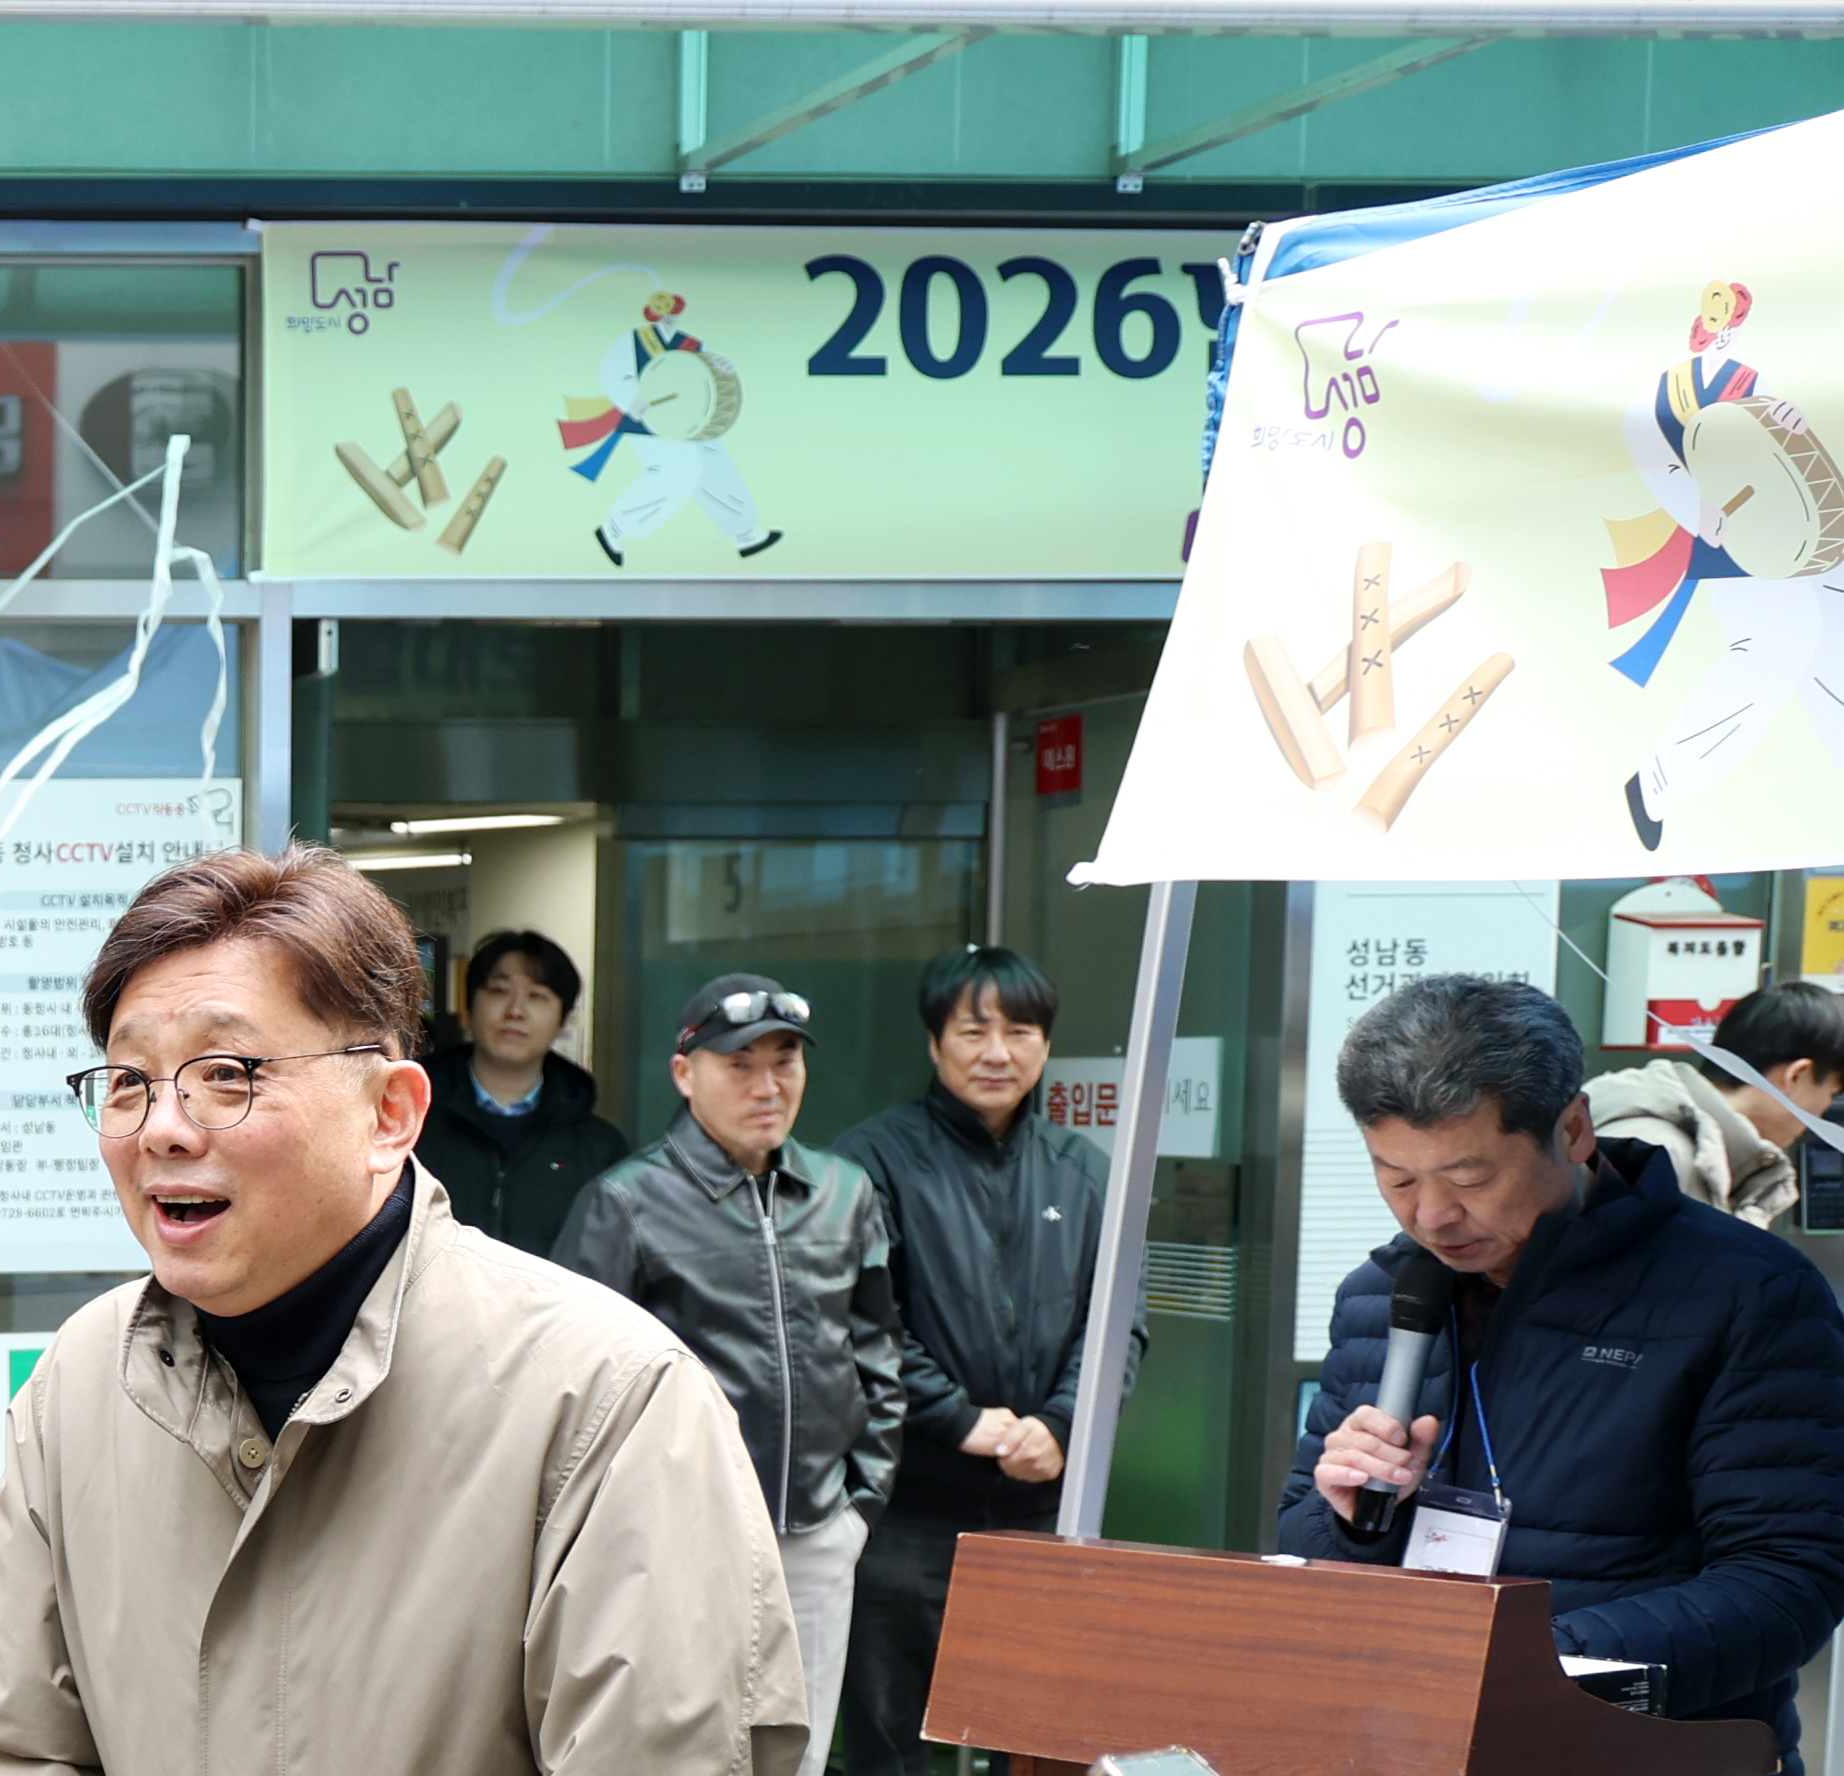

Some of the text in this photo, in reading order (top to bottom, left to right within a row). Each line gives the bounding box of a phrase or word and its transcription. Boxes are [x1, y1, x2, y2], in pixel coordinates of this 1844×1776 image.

[41, 894, 76, 906] CCTV
[1346, 938, 1429, 966] 성남동
[1045, 1078, 1212, 1127] 출입문 세요
